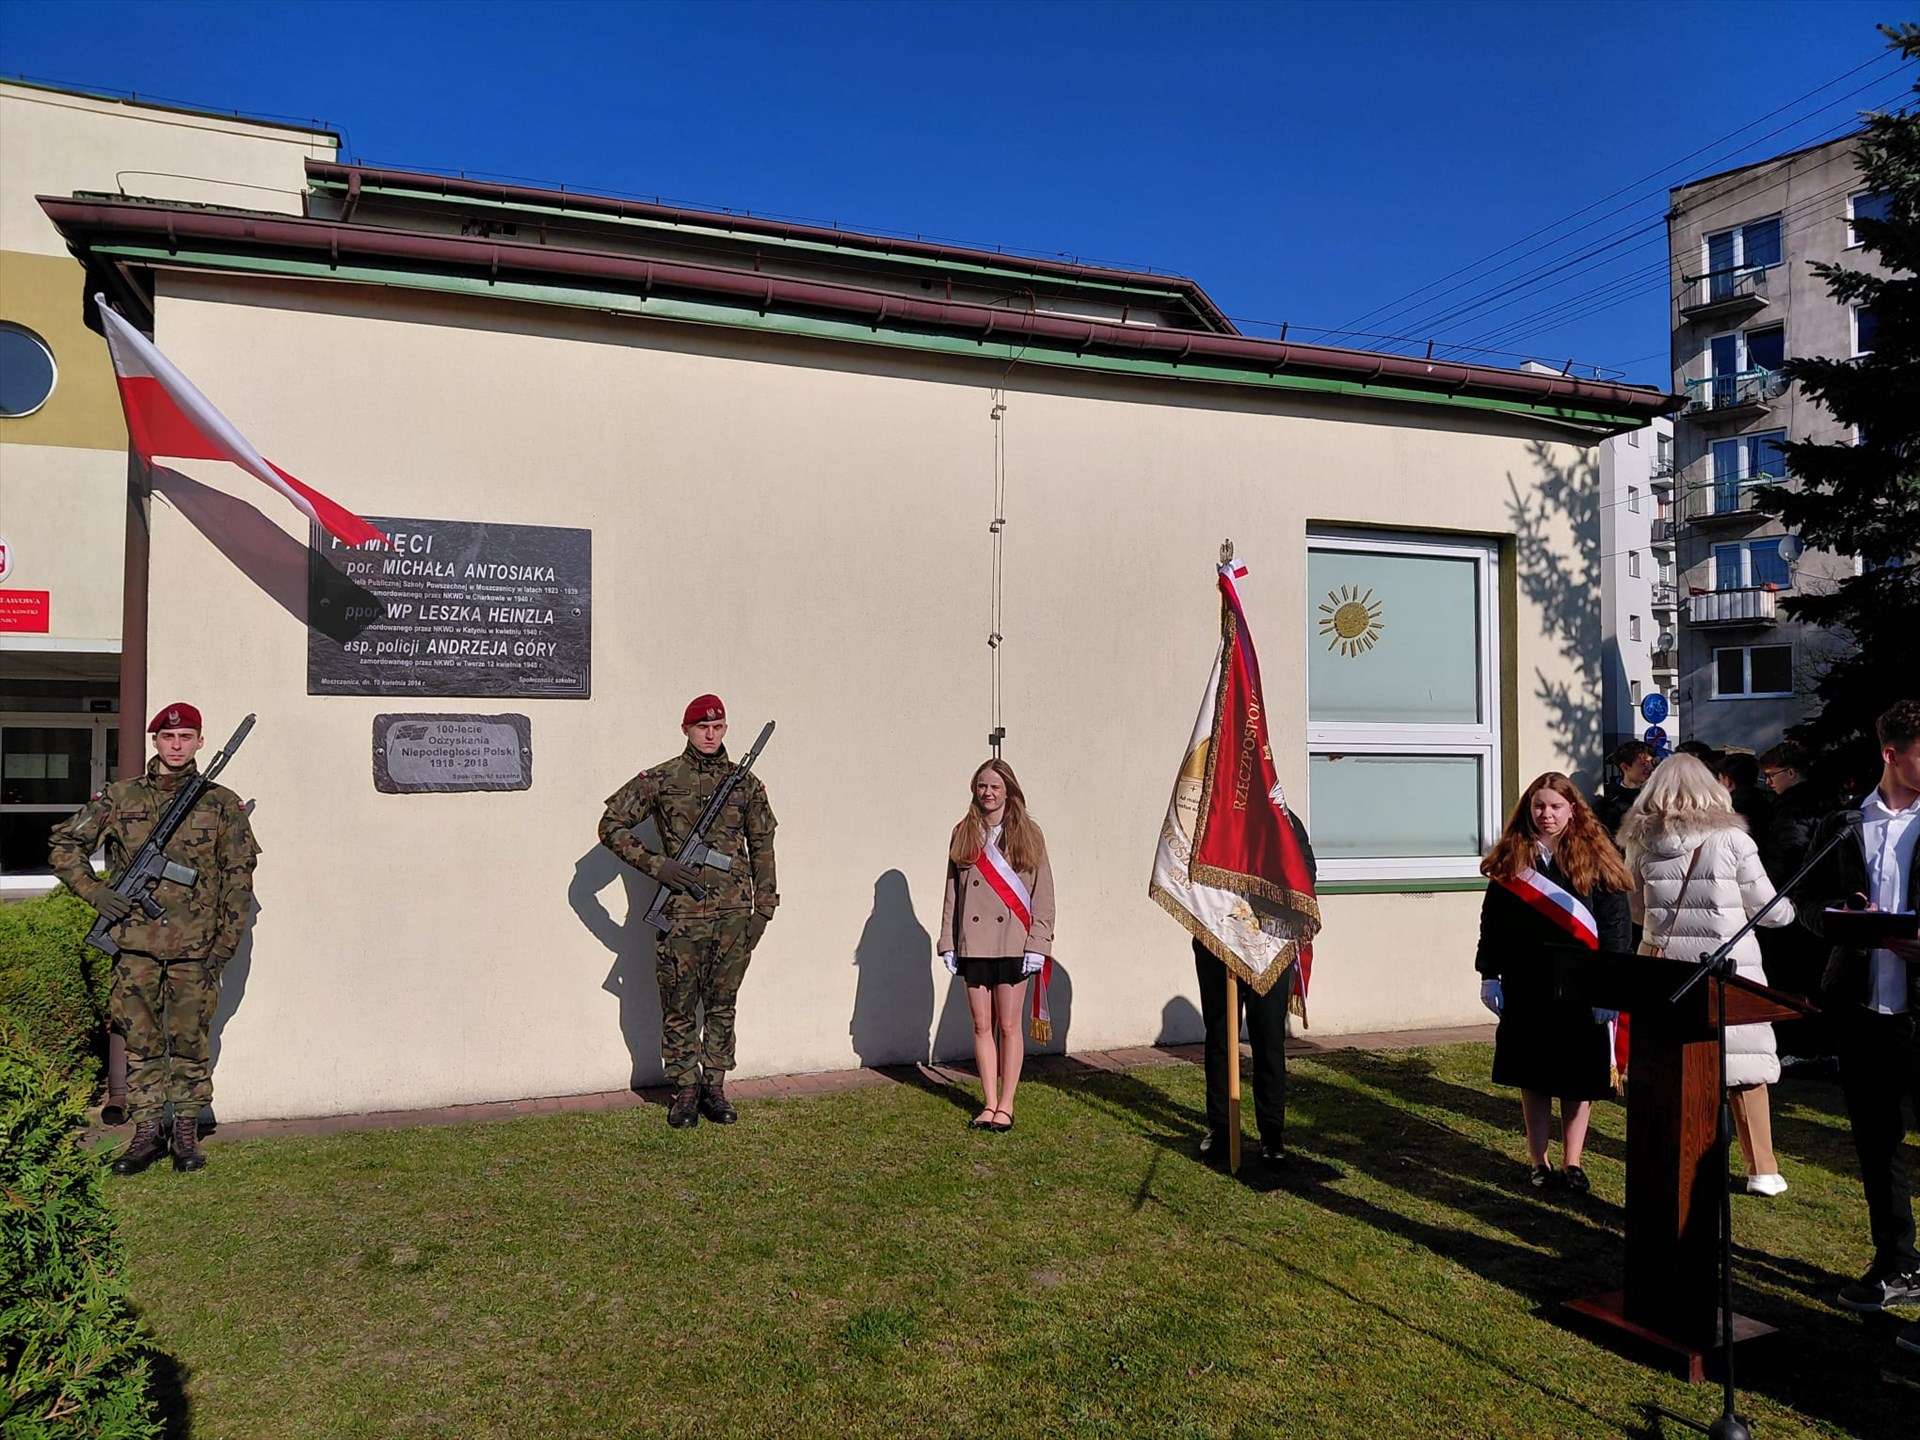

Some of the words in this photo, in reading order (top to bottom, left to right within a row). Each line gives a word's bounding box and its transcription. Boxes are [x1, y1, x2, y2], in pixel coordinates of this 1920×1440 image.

[346, 561, 374, 576] por.
[382, 559, 455, 577] MICHAŁA
[464, 563, 555, 582] ANTOSIAKA
[368, 579, 402, 588] Publicznej
[403, 580, 425, 590] Szkoły
[426, 581, 468, 591] Powszechnej
[476, 584, 515, 593] Moszczenicy
[443, 592, 463, 600] NKWD
[472, 593, 505, 602] Charkowie
[345, 606, 382, 620] ppor.
[387, 603, 412, 619] WP
[419, 604, 481, 622] LESZKA
[488, 607, 554, 624] HEINZLA
[414, 626, 432, 634] przez
[463, 627, 486, 635] Katyniu
[344, 640, 373, 655] asp.
[376, 639, 420, 656] policji
[426, 639, 508, 656] ANDRZEJA
[514, 638, 557, 657] GÓRY
[360, 658, 413, 666] zamordowanego
[436, 724, 482, 734] 100-lecie
[428, 736, 490, 747] Odzyskania
[401, 747, 480, 758] Niepodległości
[483, 747, 516, 756] Polski
[430, 759, 454, 768] 1918
[464, 759, 489, 767] 2018
